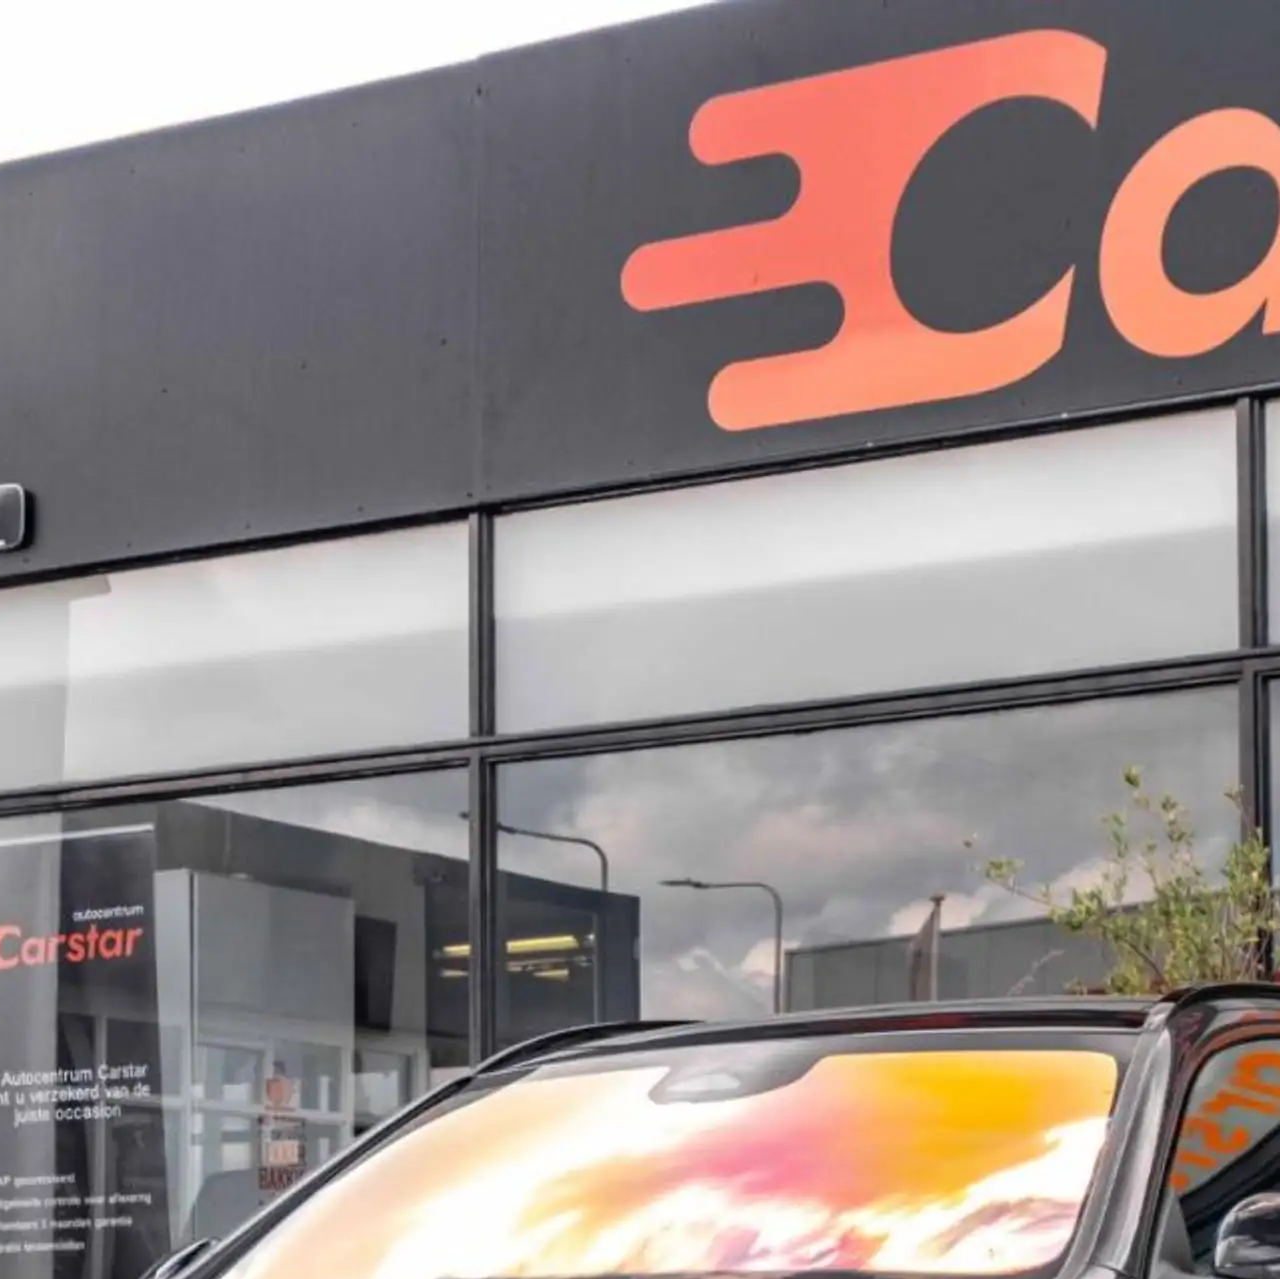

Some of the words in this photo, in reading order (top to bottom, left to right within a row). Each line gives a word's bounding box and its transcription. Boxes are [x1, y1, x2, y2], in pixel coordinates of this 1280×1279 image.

[72, 905, 144, 921] autocentrum
[0, 1067, 94, 1087] Autocentrum
[97, 1063, 149, 1081] Carstar
[15, 1092, 26, 1105] u
[29, 1084, 100, 1104] verzekerd
[104, 1086, 130, 1099] van
[132, 1082, 152, 1097] de
[54, 1103, 122, 1121] occasion
